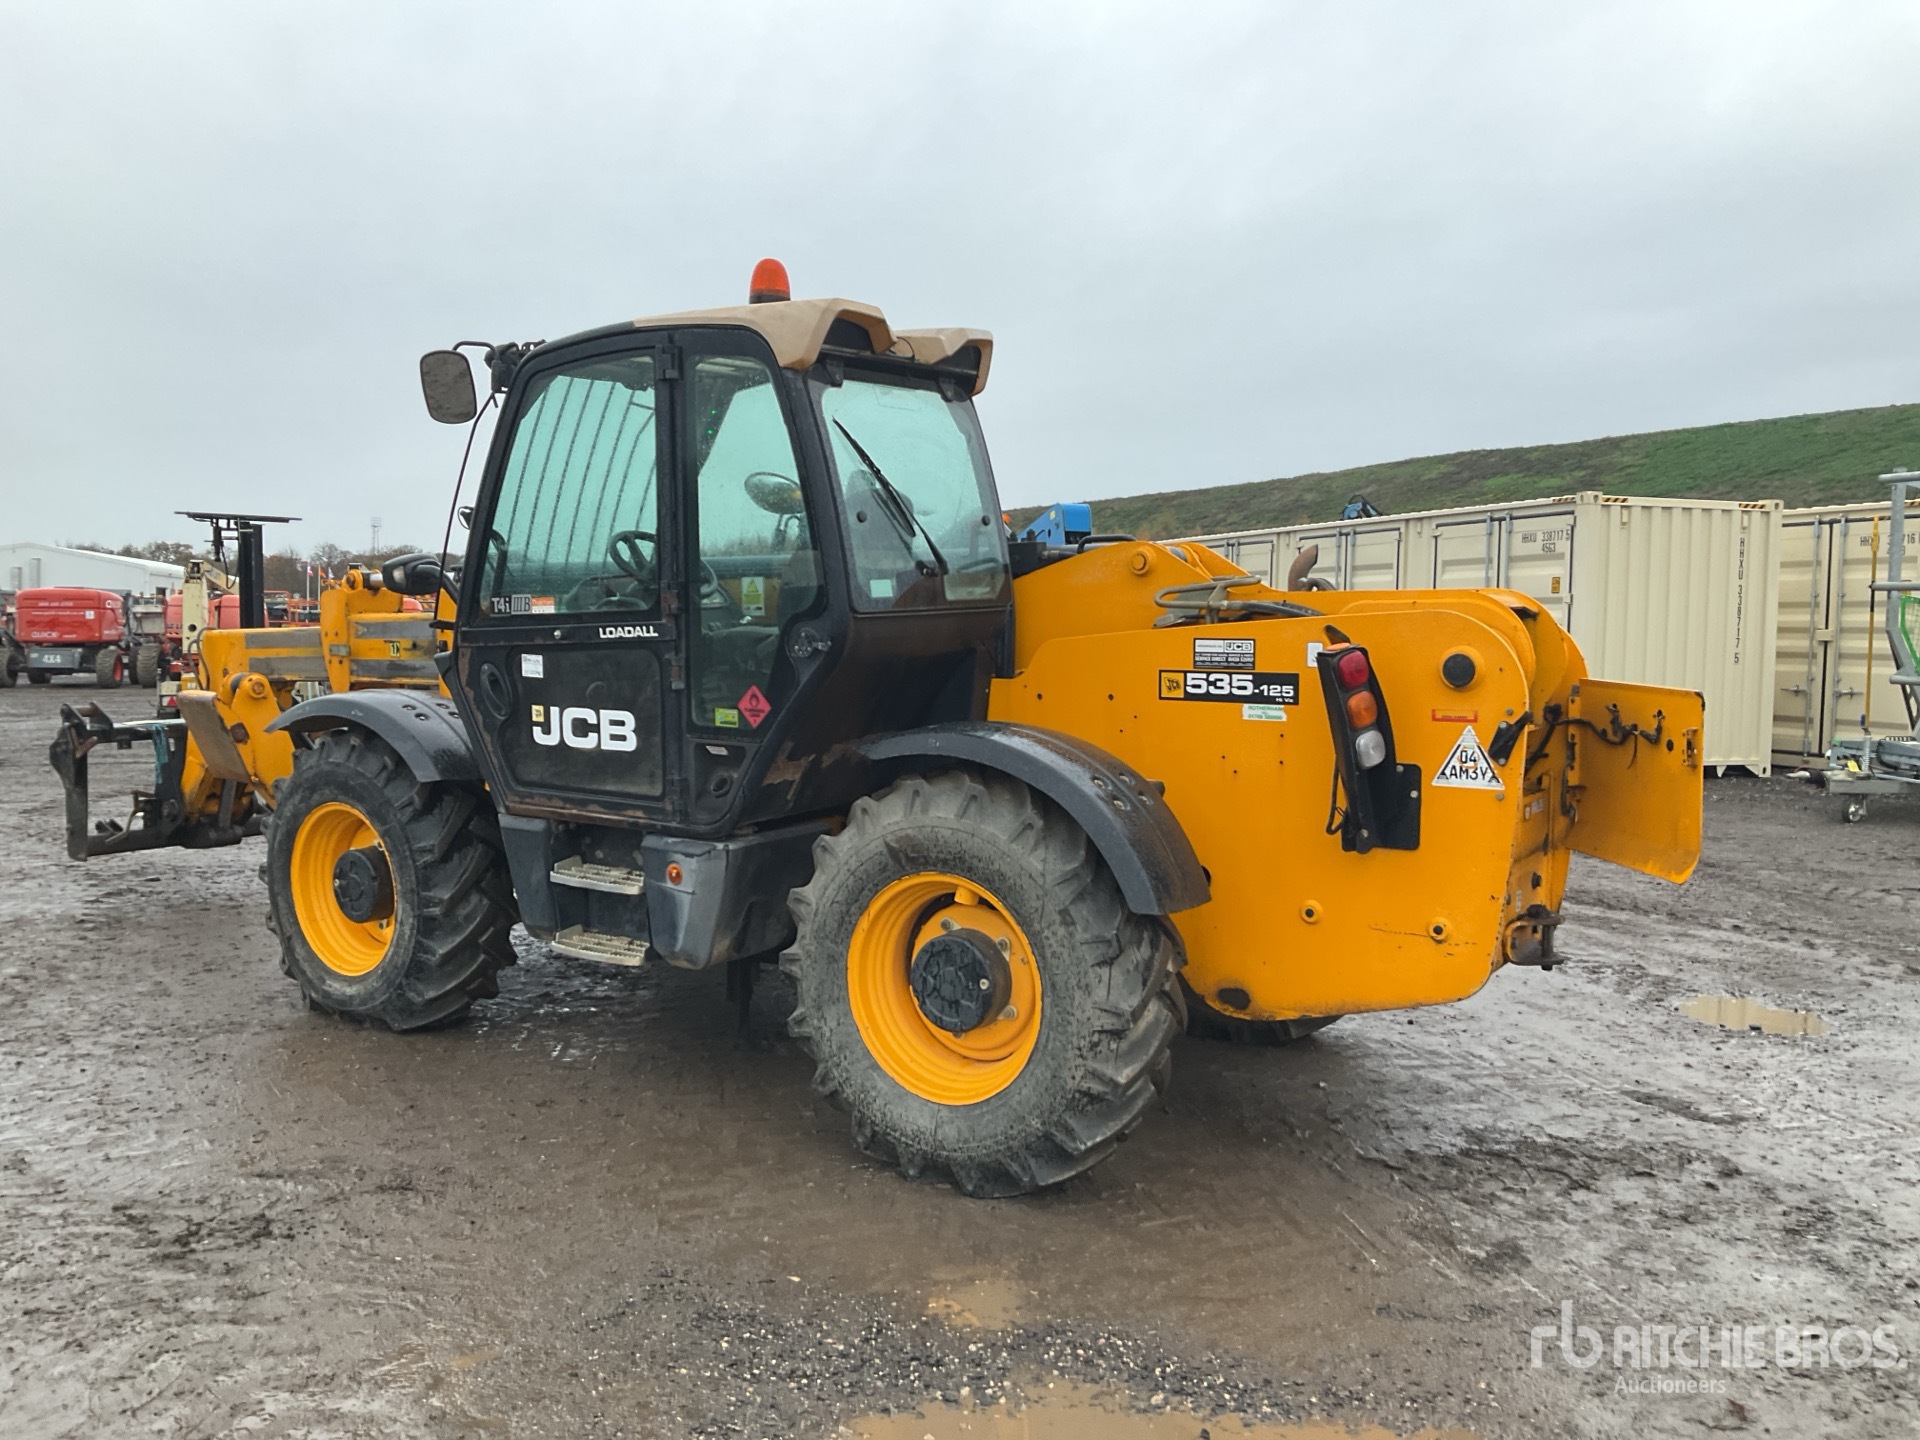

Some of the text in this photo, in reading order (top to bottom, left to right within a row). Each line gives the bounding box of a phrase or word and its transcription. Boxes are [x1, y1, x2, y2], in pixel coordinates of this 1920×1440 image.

[1521, 533, 1537, 543] HHXU
[1541, 530, 1564, 542] 338717
[1541, 542, 1556, 552] 4563
[491, 597, 511, 613] T4i
[599, 626, 658, 639] LOADALL
[1226, 642, 1252, 651] JCB
[42, 654, 61, 664] 4X4
[1734, 652, 1739, 663] 5
[1164, 677, 1182, 693] JCB
[1185, 673, 1294, 697] 535-125
[532, 705, 638, 752] JCB
[1449, 765, 1488, 780] AM3Y
